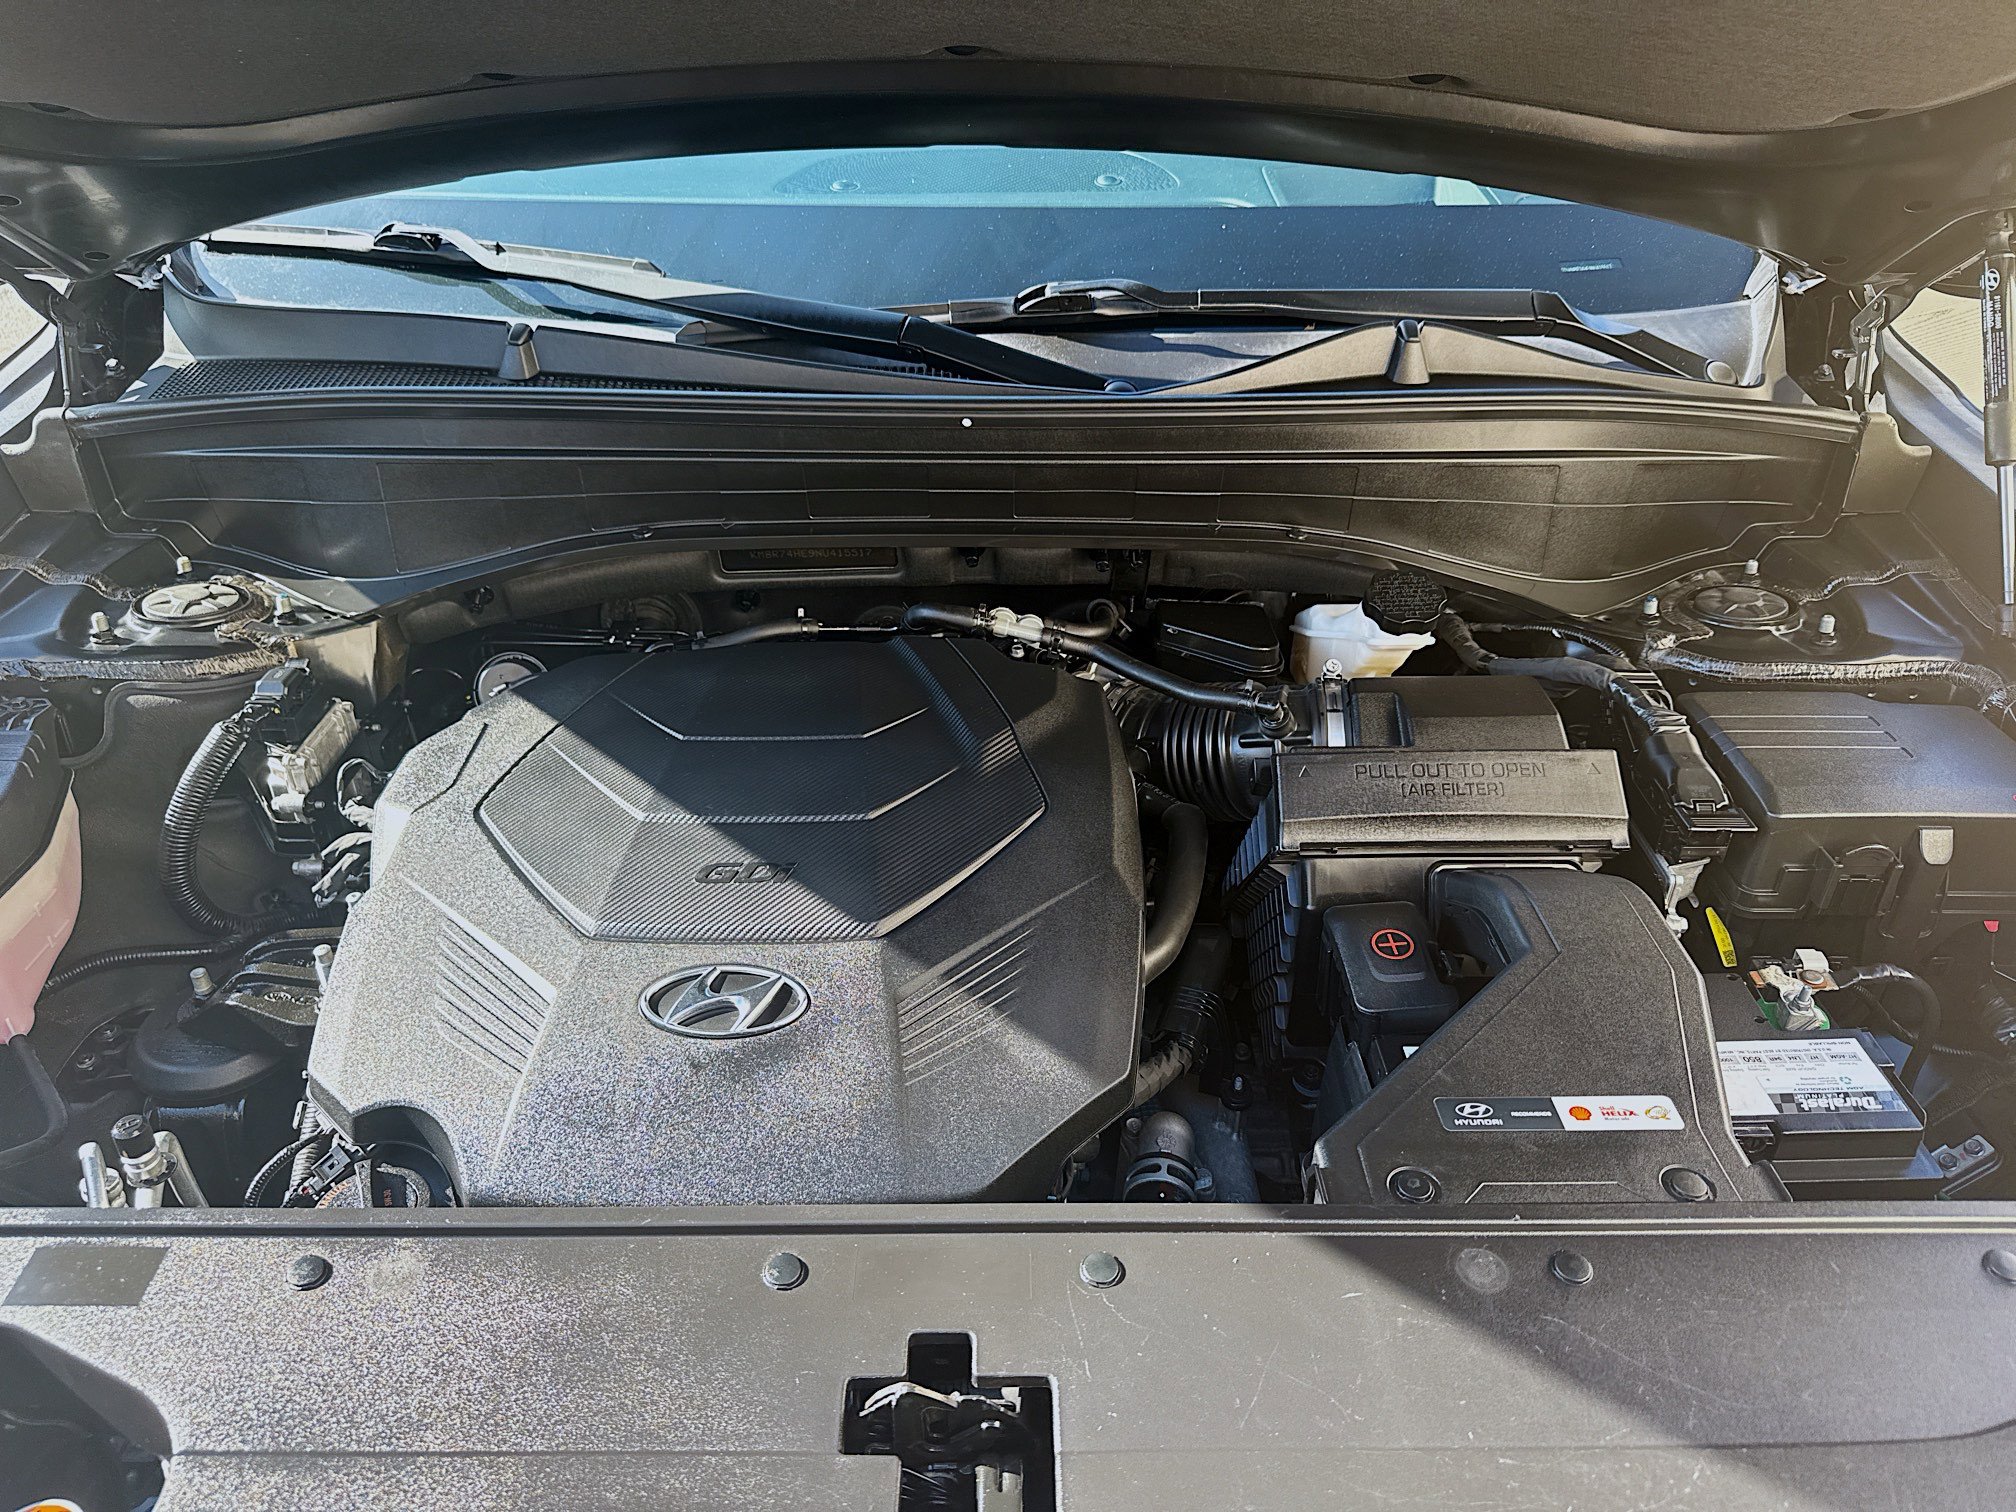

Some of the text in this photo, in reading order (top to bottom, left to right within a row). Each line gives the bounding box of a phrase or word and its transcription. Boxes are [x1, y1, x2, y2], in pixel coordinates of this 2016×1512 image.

[1354, 762, 1546, 779] PULL OUT TO OPEN
[1799, 1096, 1882, 1111] Duralast
[1600, 1109, 1639, 1118] HELIX
[1454, 1118, 1503, 1126] HYUNDAI
